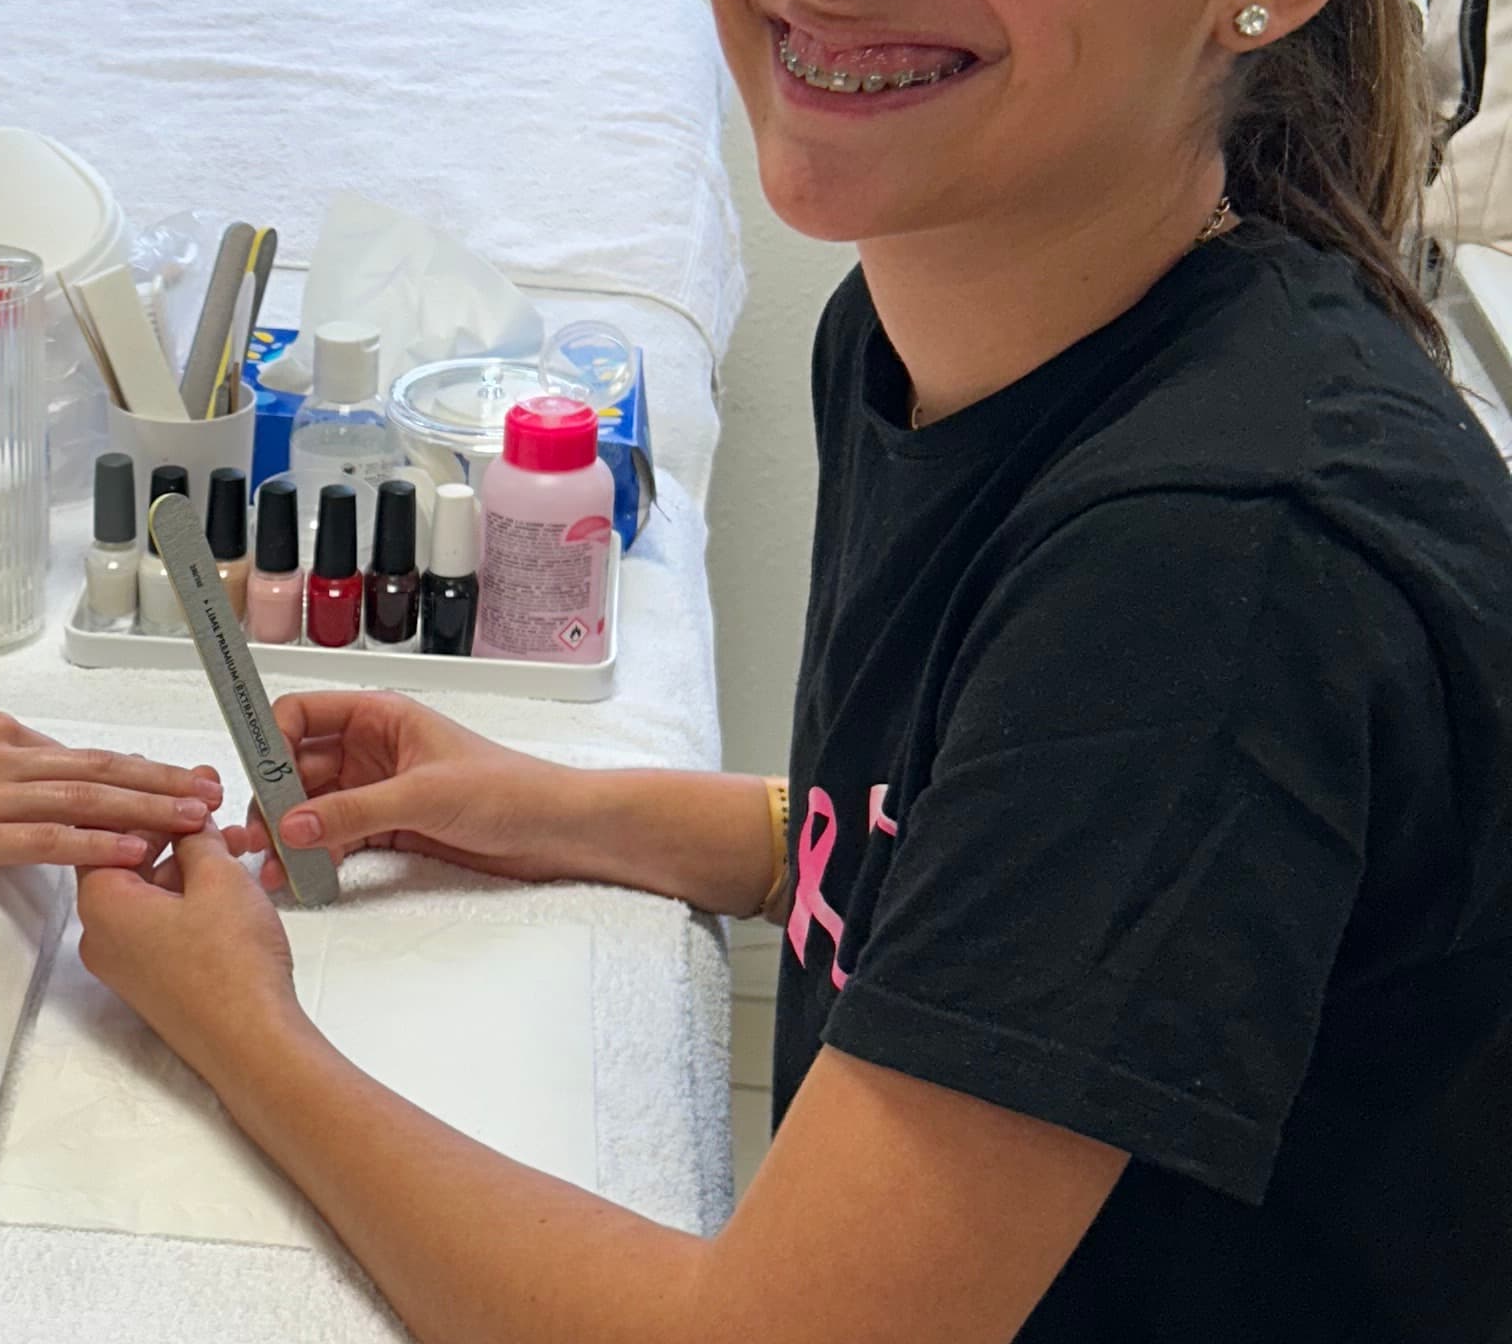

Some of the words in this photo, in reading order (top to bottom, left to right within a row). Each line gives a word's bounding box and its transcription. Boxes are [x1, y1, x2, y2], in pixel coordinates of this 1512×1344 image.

[205, 607, 221, 632] LIME
[216, 632, 240, 681] PREMIUM
[235, 683, 254, 719] EXTRA
[249, 718, 269, 755] DOUCE
